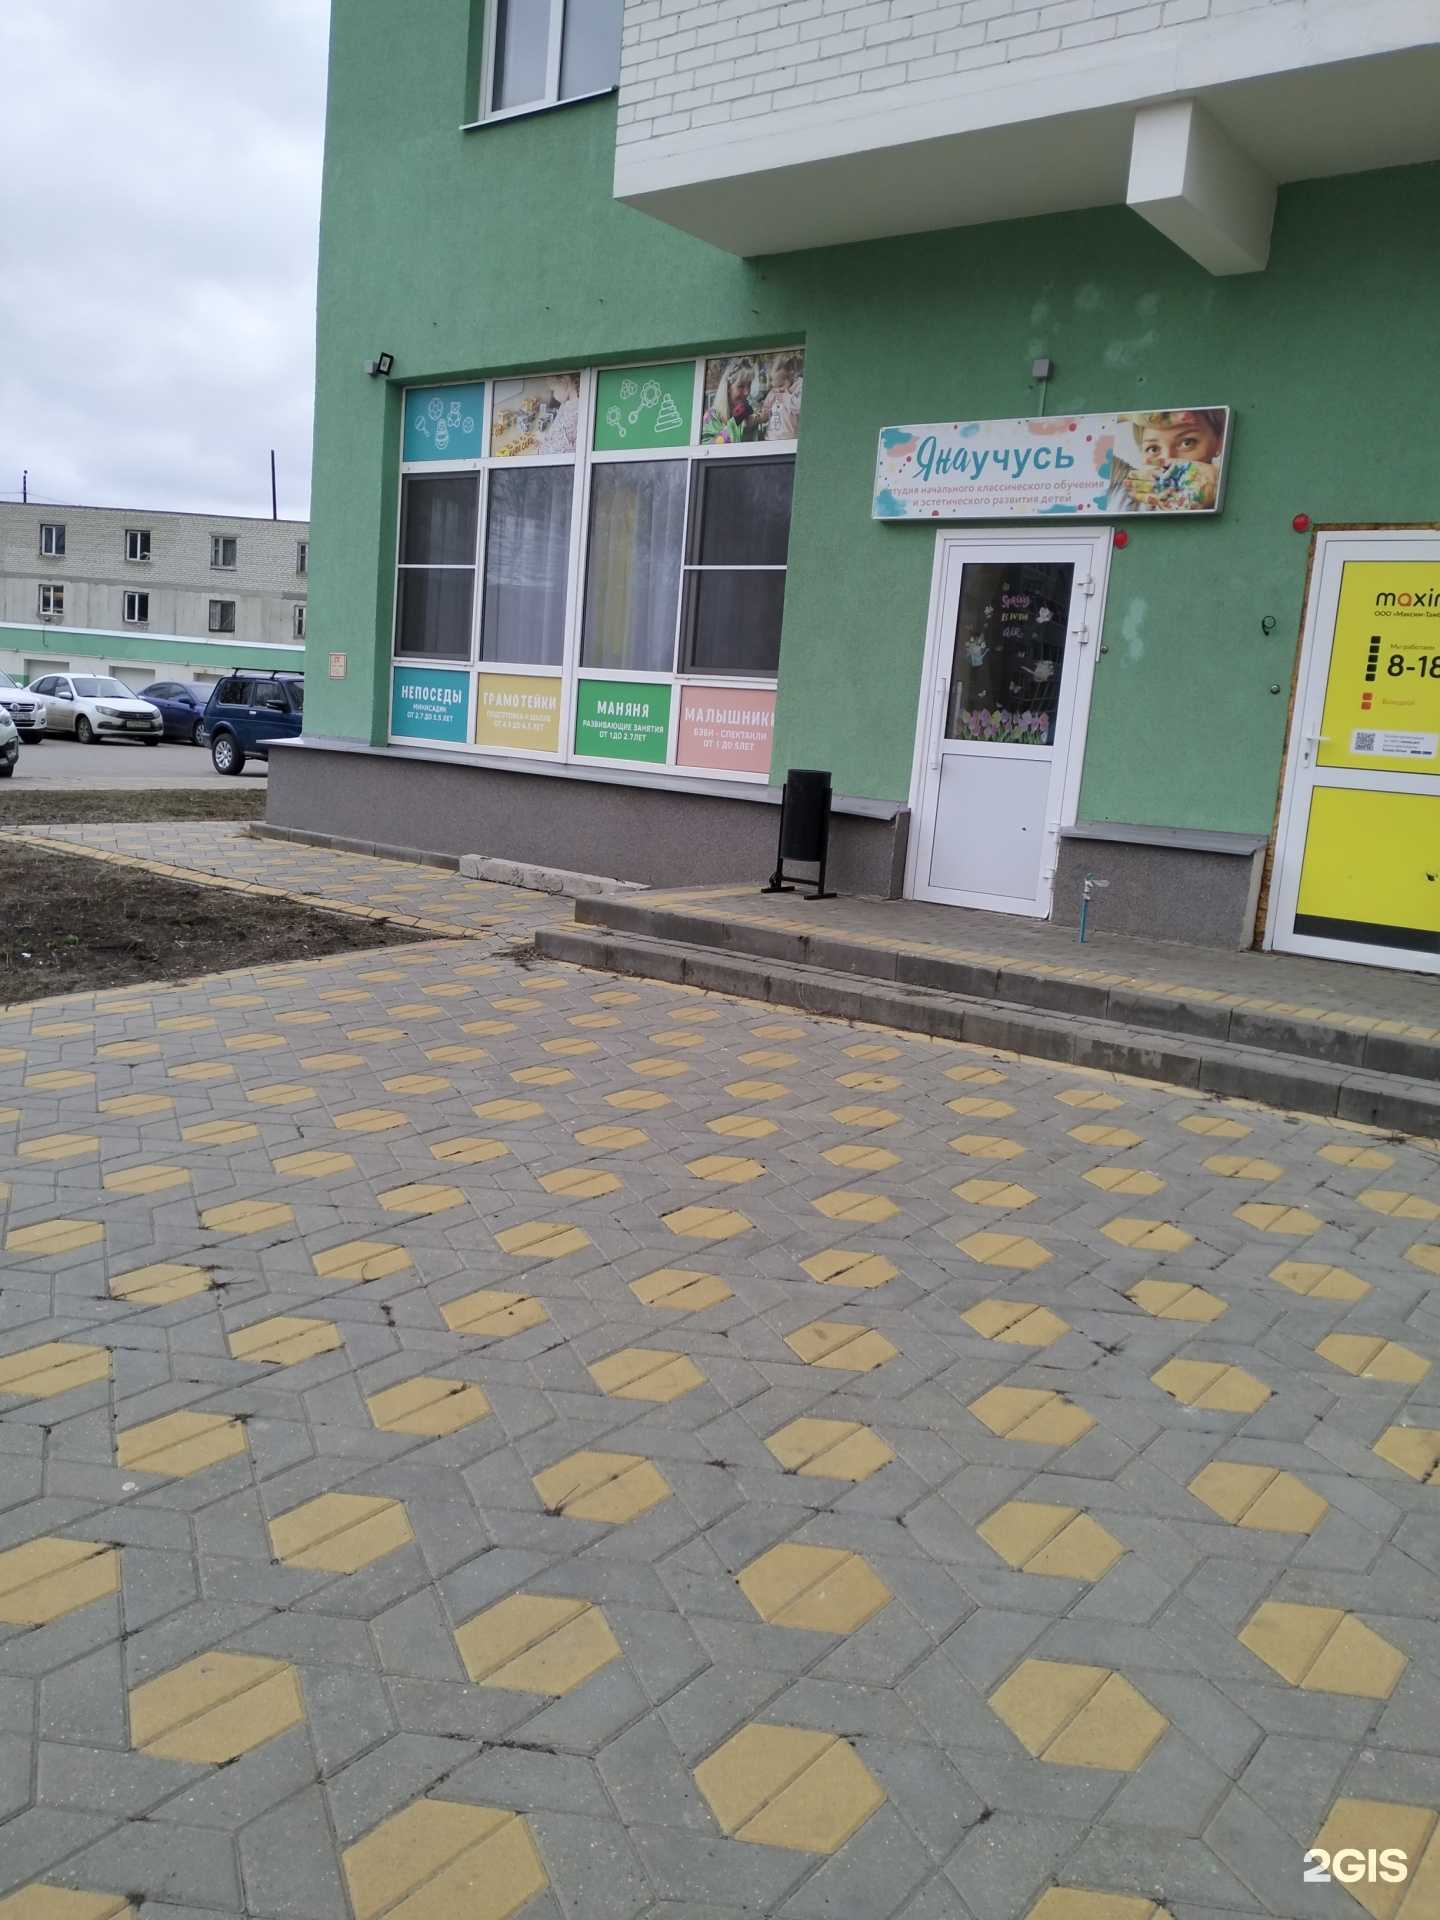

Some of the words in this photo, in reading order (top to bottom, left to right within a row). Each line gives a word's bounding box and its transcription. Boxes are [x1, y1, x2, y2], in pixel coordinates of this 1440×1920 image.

[921, 485, 974, 496] начального
[977, 482, 1051, 493] классического
[1053, 479, 1104, 492] обучения
[920, 497, 990, 507] эстетического
[992, 495, 1039, 506] развития
[1041, 492, 1072, 504] детей
[401, 685, 462, 705] НЕПОСЕДЫ
[597, 700, 649, 718] МАНЯНЯ
[582, 719, 631, 731] РАЗВИВАЮЩИЕ
[633, 724, 664, 734] ЗАНЯТИЯ
[600, 730, 608, 738] ОТ
